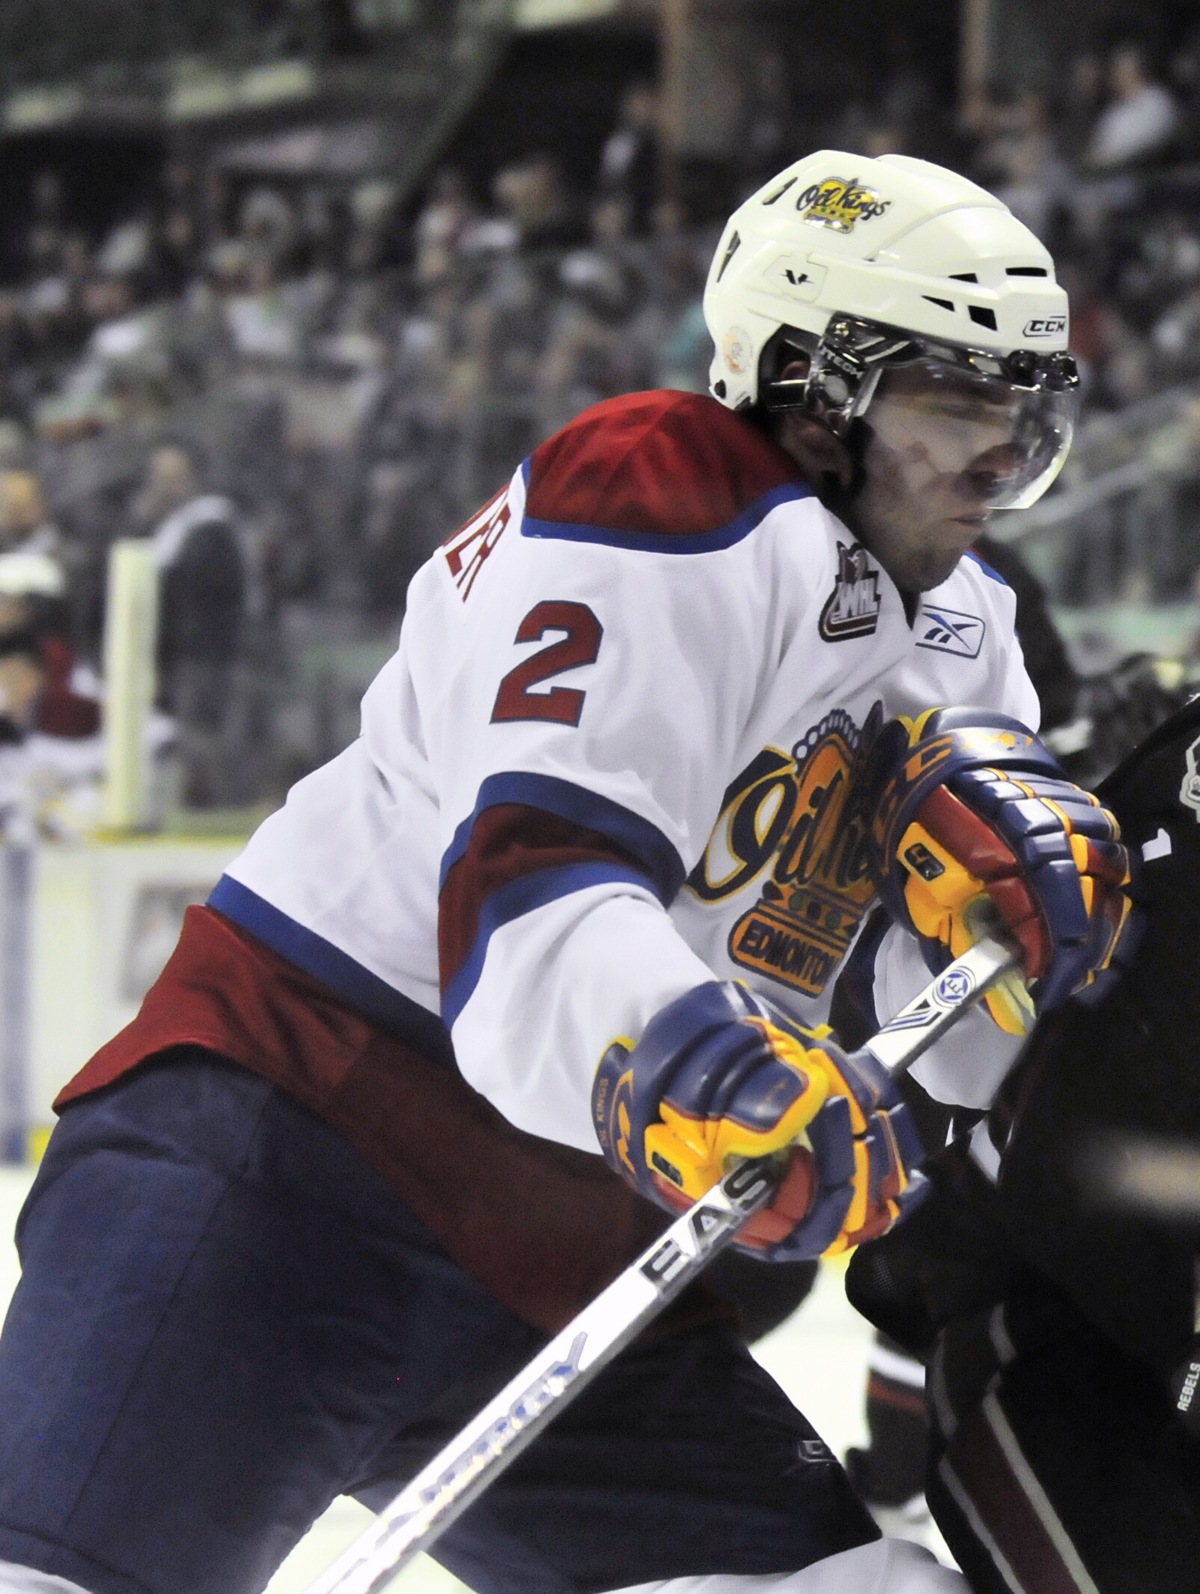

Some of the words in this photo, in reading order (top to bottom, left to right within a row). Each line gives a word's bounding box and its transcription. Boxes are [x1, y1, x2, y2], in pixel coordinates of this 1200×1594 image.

[835, 184, 891, 221] Kings
[1030, 320, 1065, 332] CCM
[489, 600, 604, 728] 2
